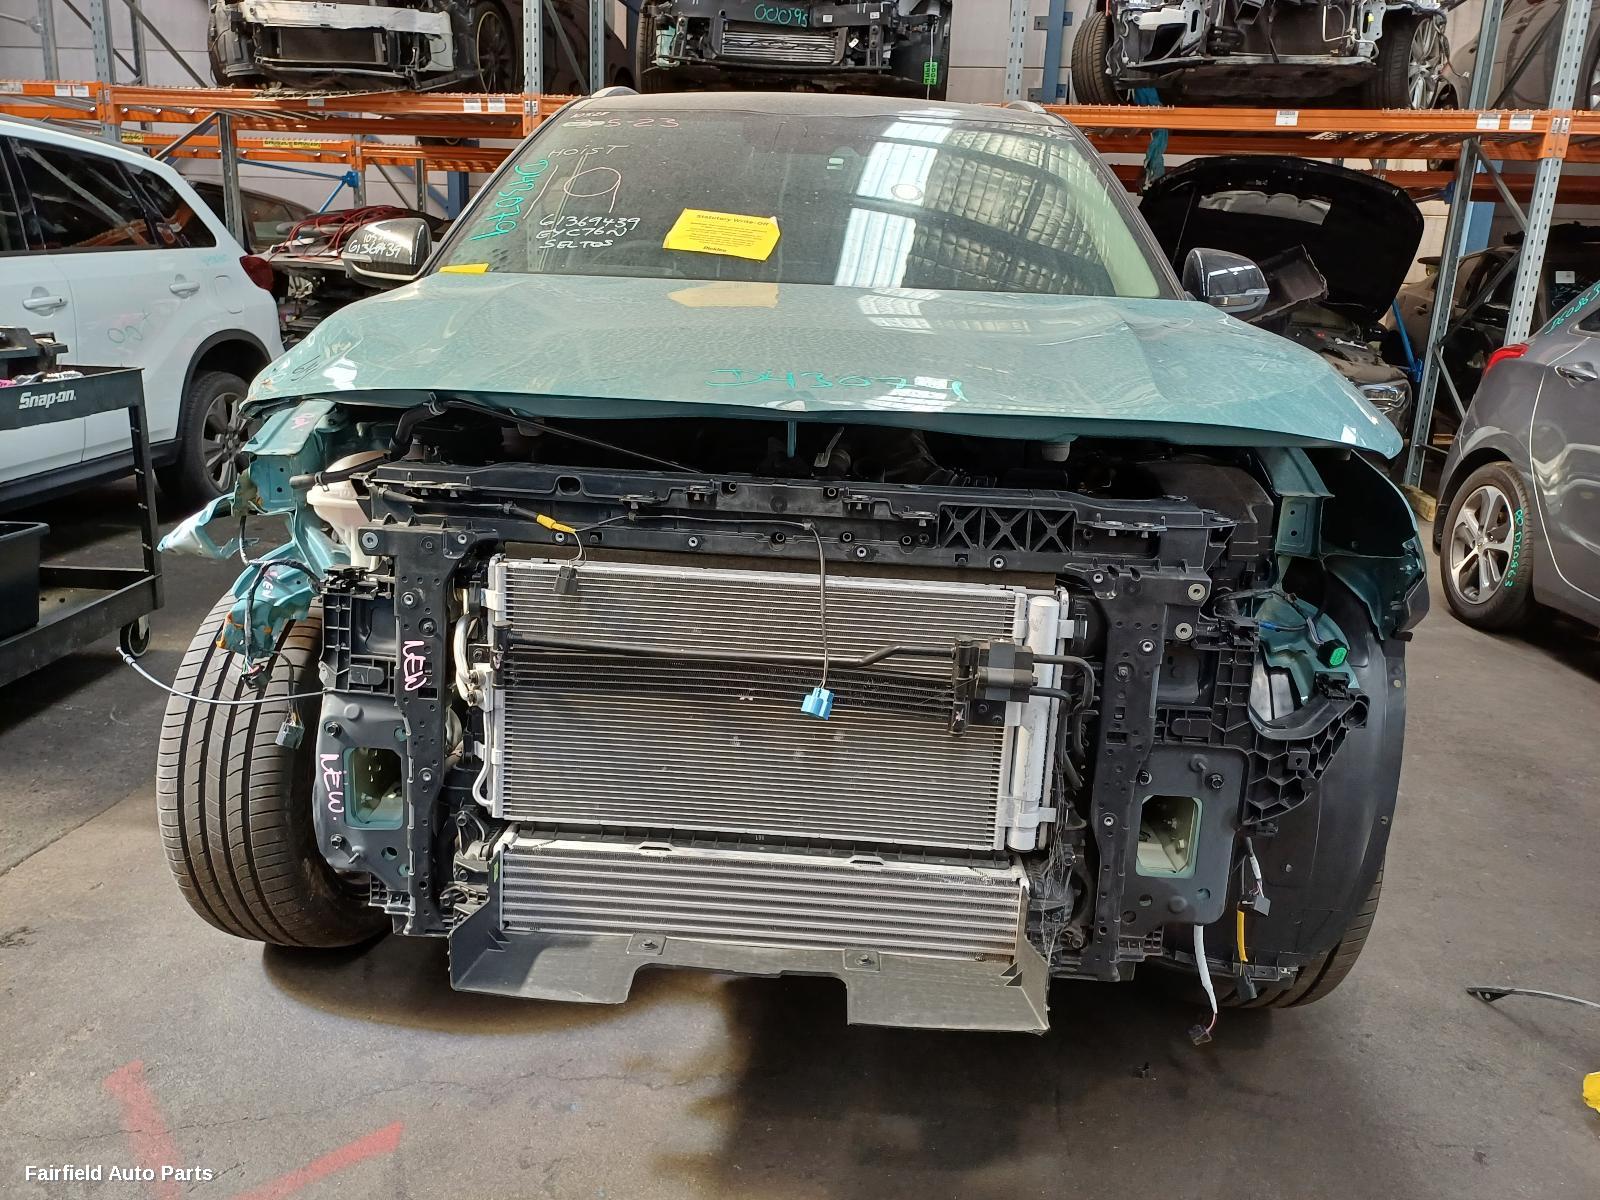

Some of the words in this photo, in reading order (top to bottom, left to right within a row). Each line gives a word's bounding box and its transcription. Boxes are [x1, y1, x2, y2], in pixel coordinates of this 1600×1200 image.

[696, 214, 731, 222] Statutory
[539, 239, 614, 249] SELTOS
[19, 389, 76, 410] Snap-on
